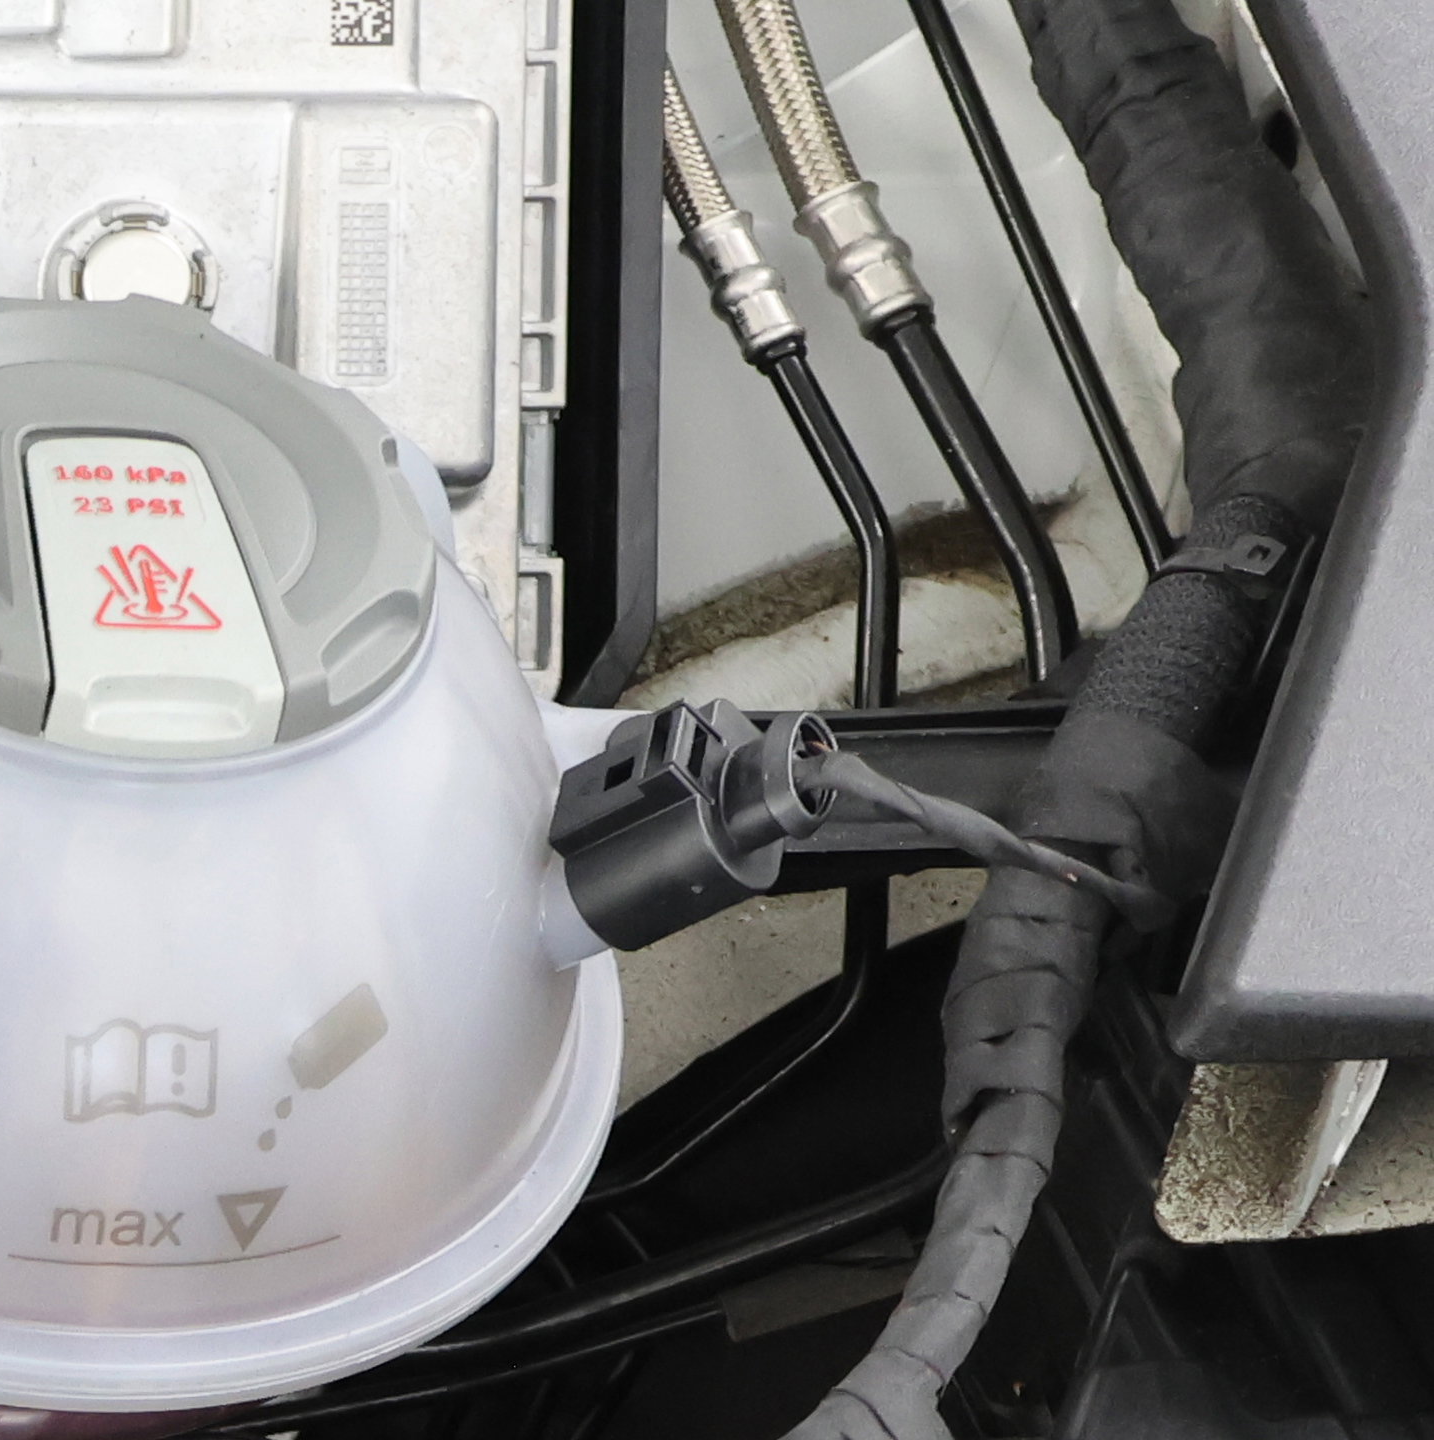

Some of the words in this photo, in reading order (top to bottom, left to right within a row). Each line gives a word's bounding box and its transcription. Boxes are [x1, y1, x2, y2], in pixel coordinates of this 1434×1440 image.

[52, 464, 114, 485] 160
[125, 464, 187, 486] kPa
[72, 495, 115, 516] 23
[125, 496, 186, 517] PSI
[49, 1205, 184, 1248] max
